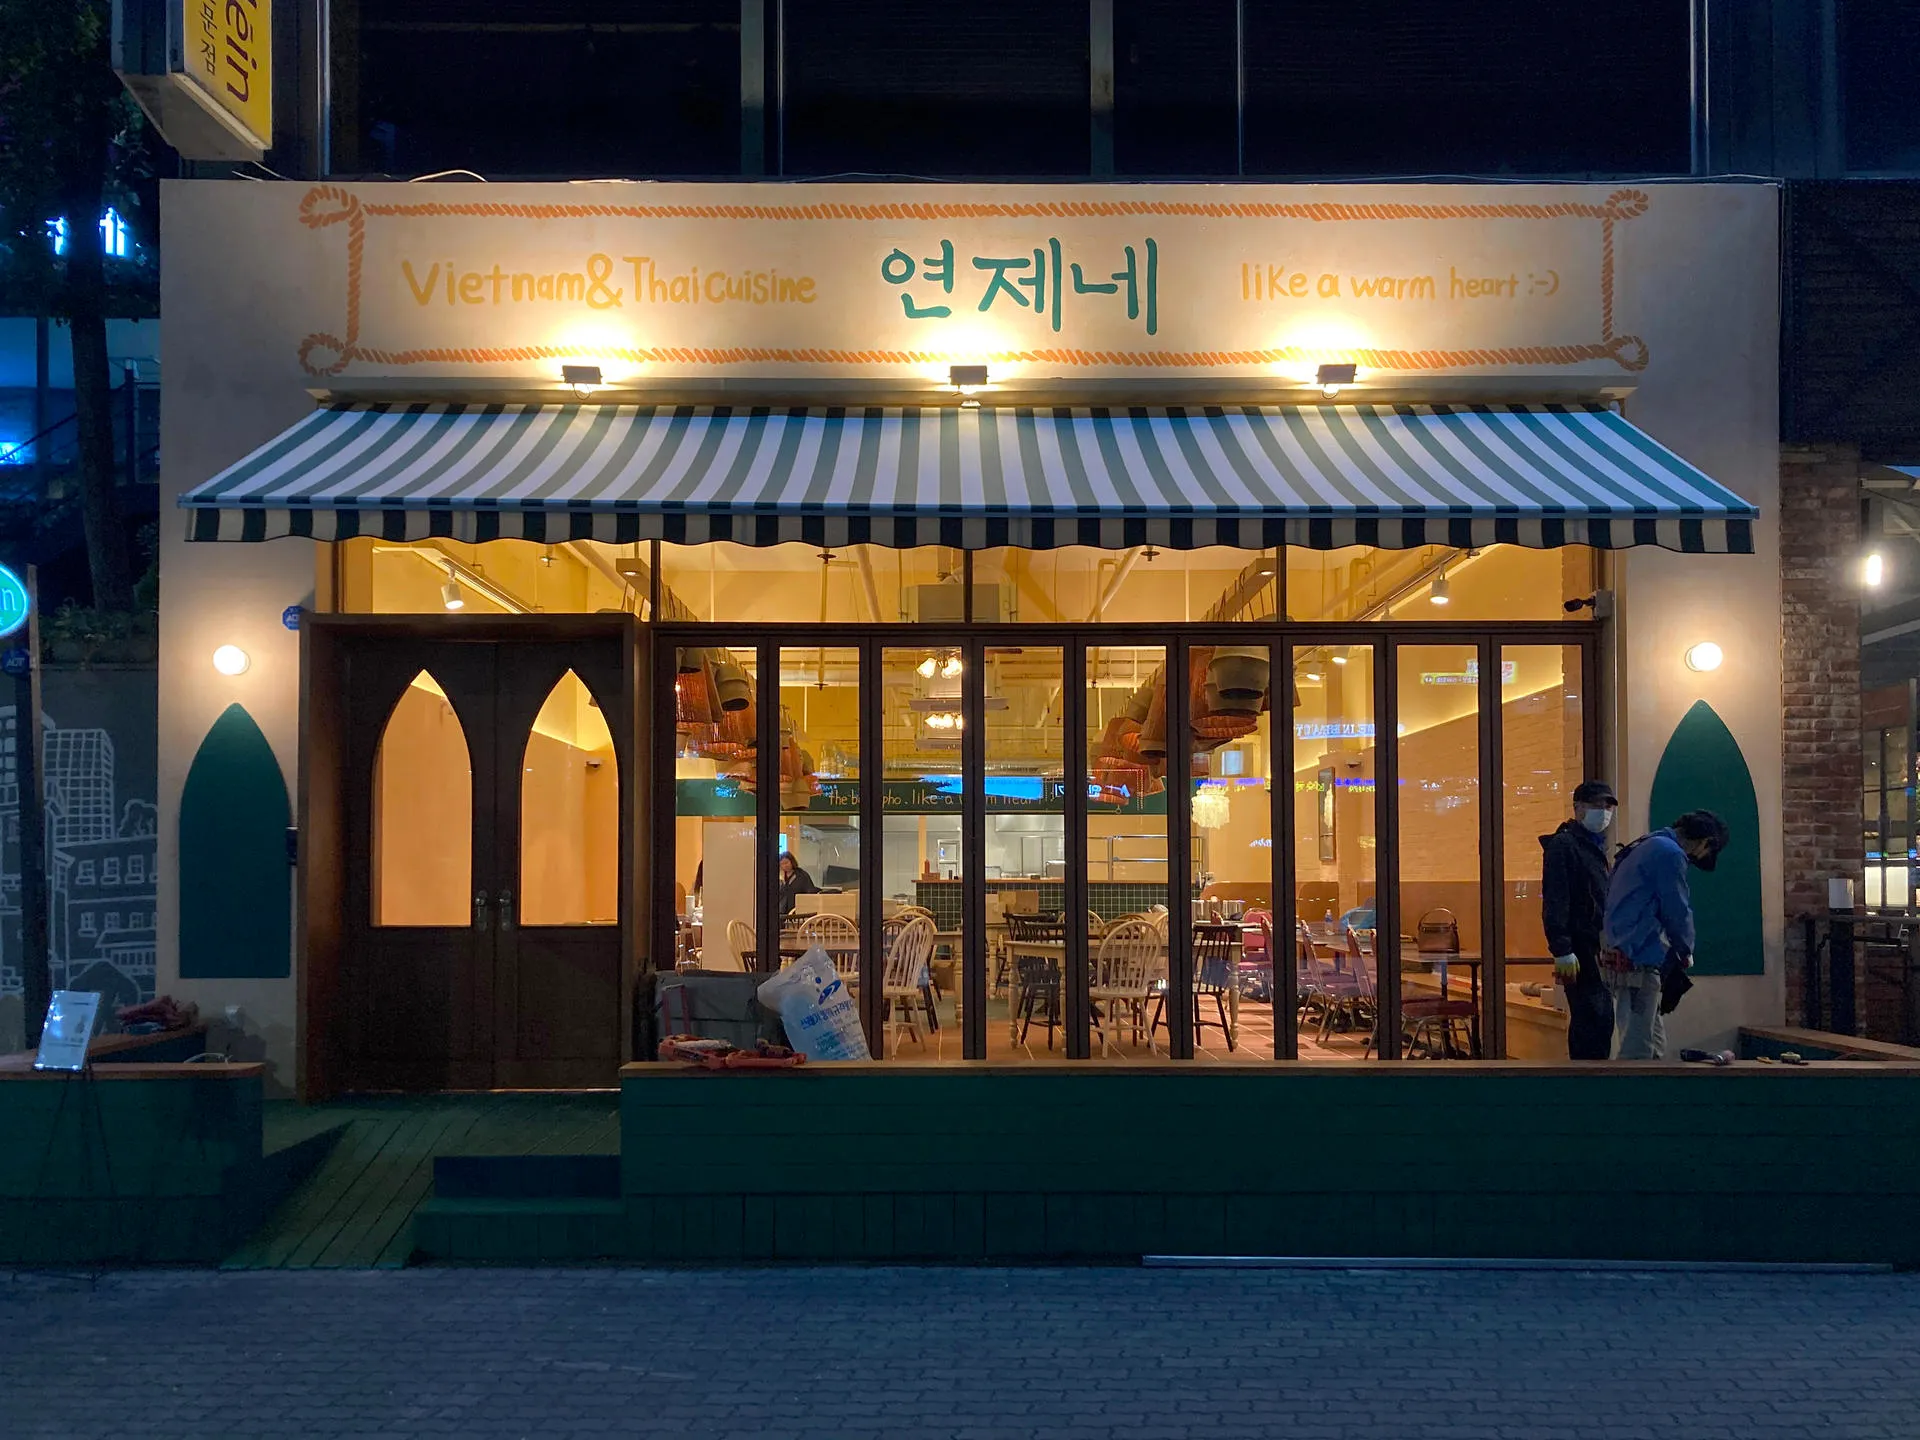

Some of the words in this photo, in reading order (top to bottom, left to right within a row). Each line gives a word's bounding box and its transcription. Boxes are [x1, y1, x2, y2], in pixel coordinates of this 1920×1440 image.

[882, 237, 1158, 335] 연제네
[1317, 273, 1341, 298] a
[1351, 275, 1436, 300] warm
[1450, 266, 1519, 298] heart
